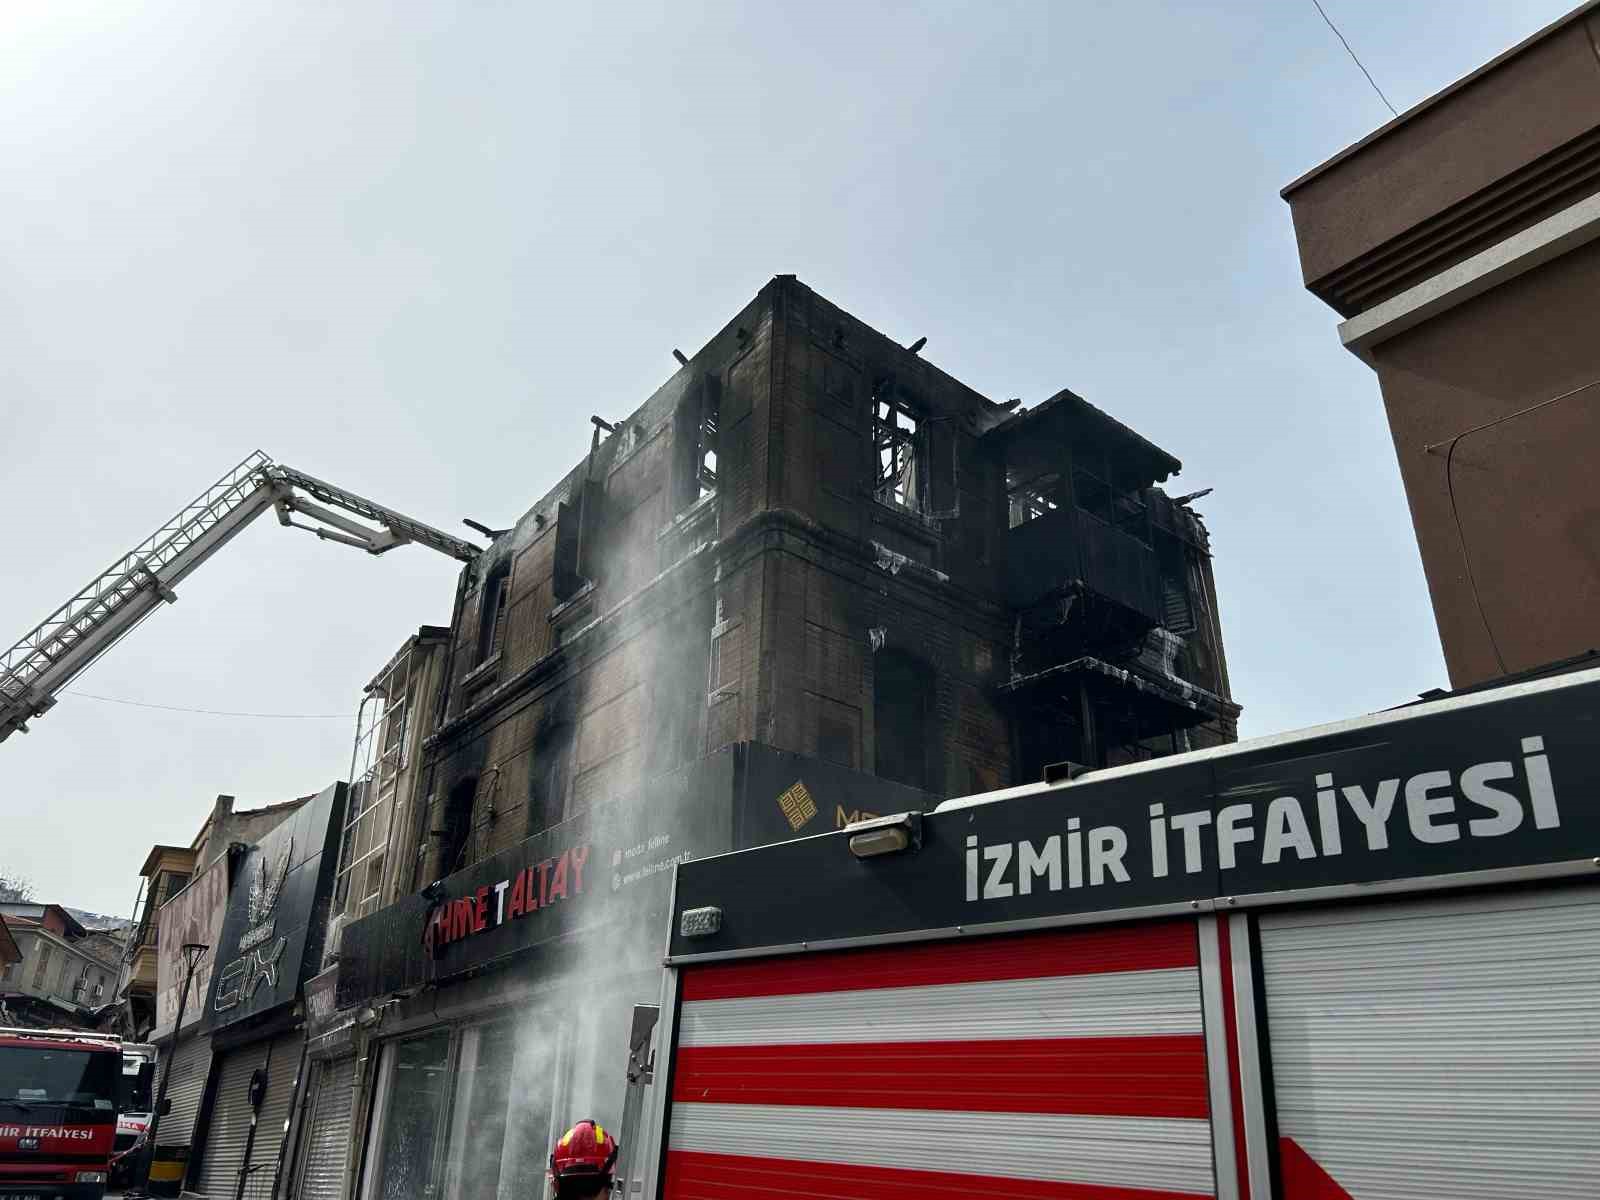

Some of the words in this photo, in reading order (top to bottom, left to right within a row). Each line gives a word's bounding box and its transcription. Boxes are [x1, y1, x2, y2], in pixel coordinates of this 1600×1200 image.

[965, 817, 1131, 902] İZMİR
[1150, 735, 1561, 878] İTFAİYESİ
[508, 847, 590, 921] ALTAY
[25, 1126, 93, 1140] İTFAİYESİ
